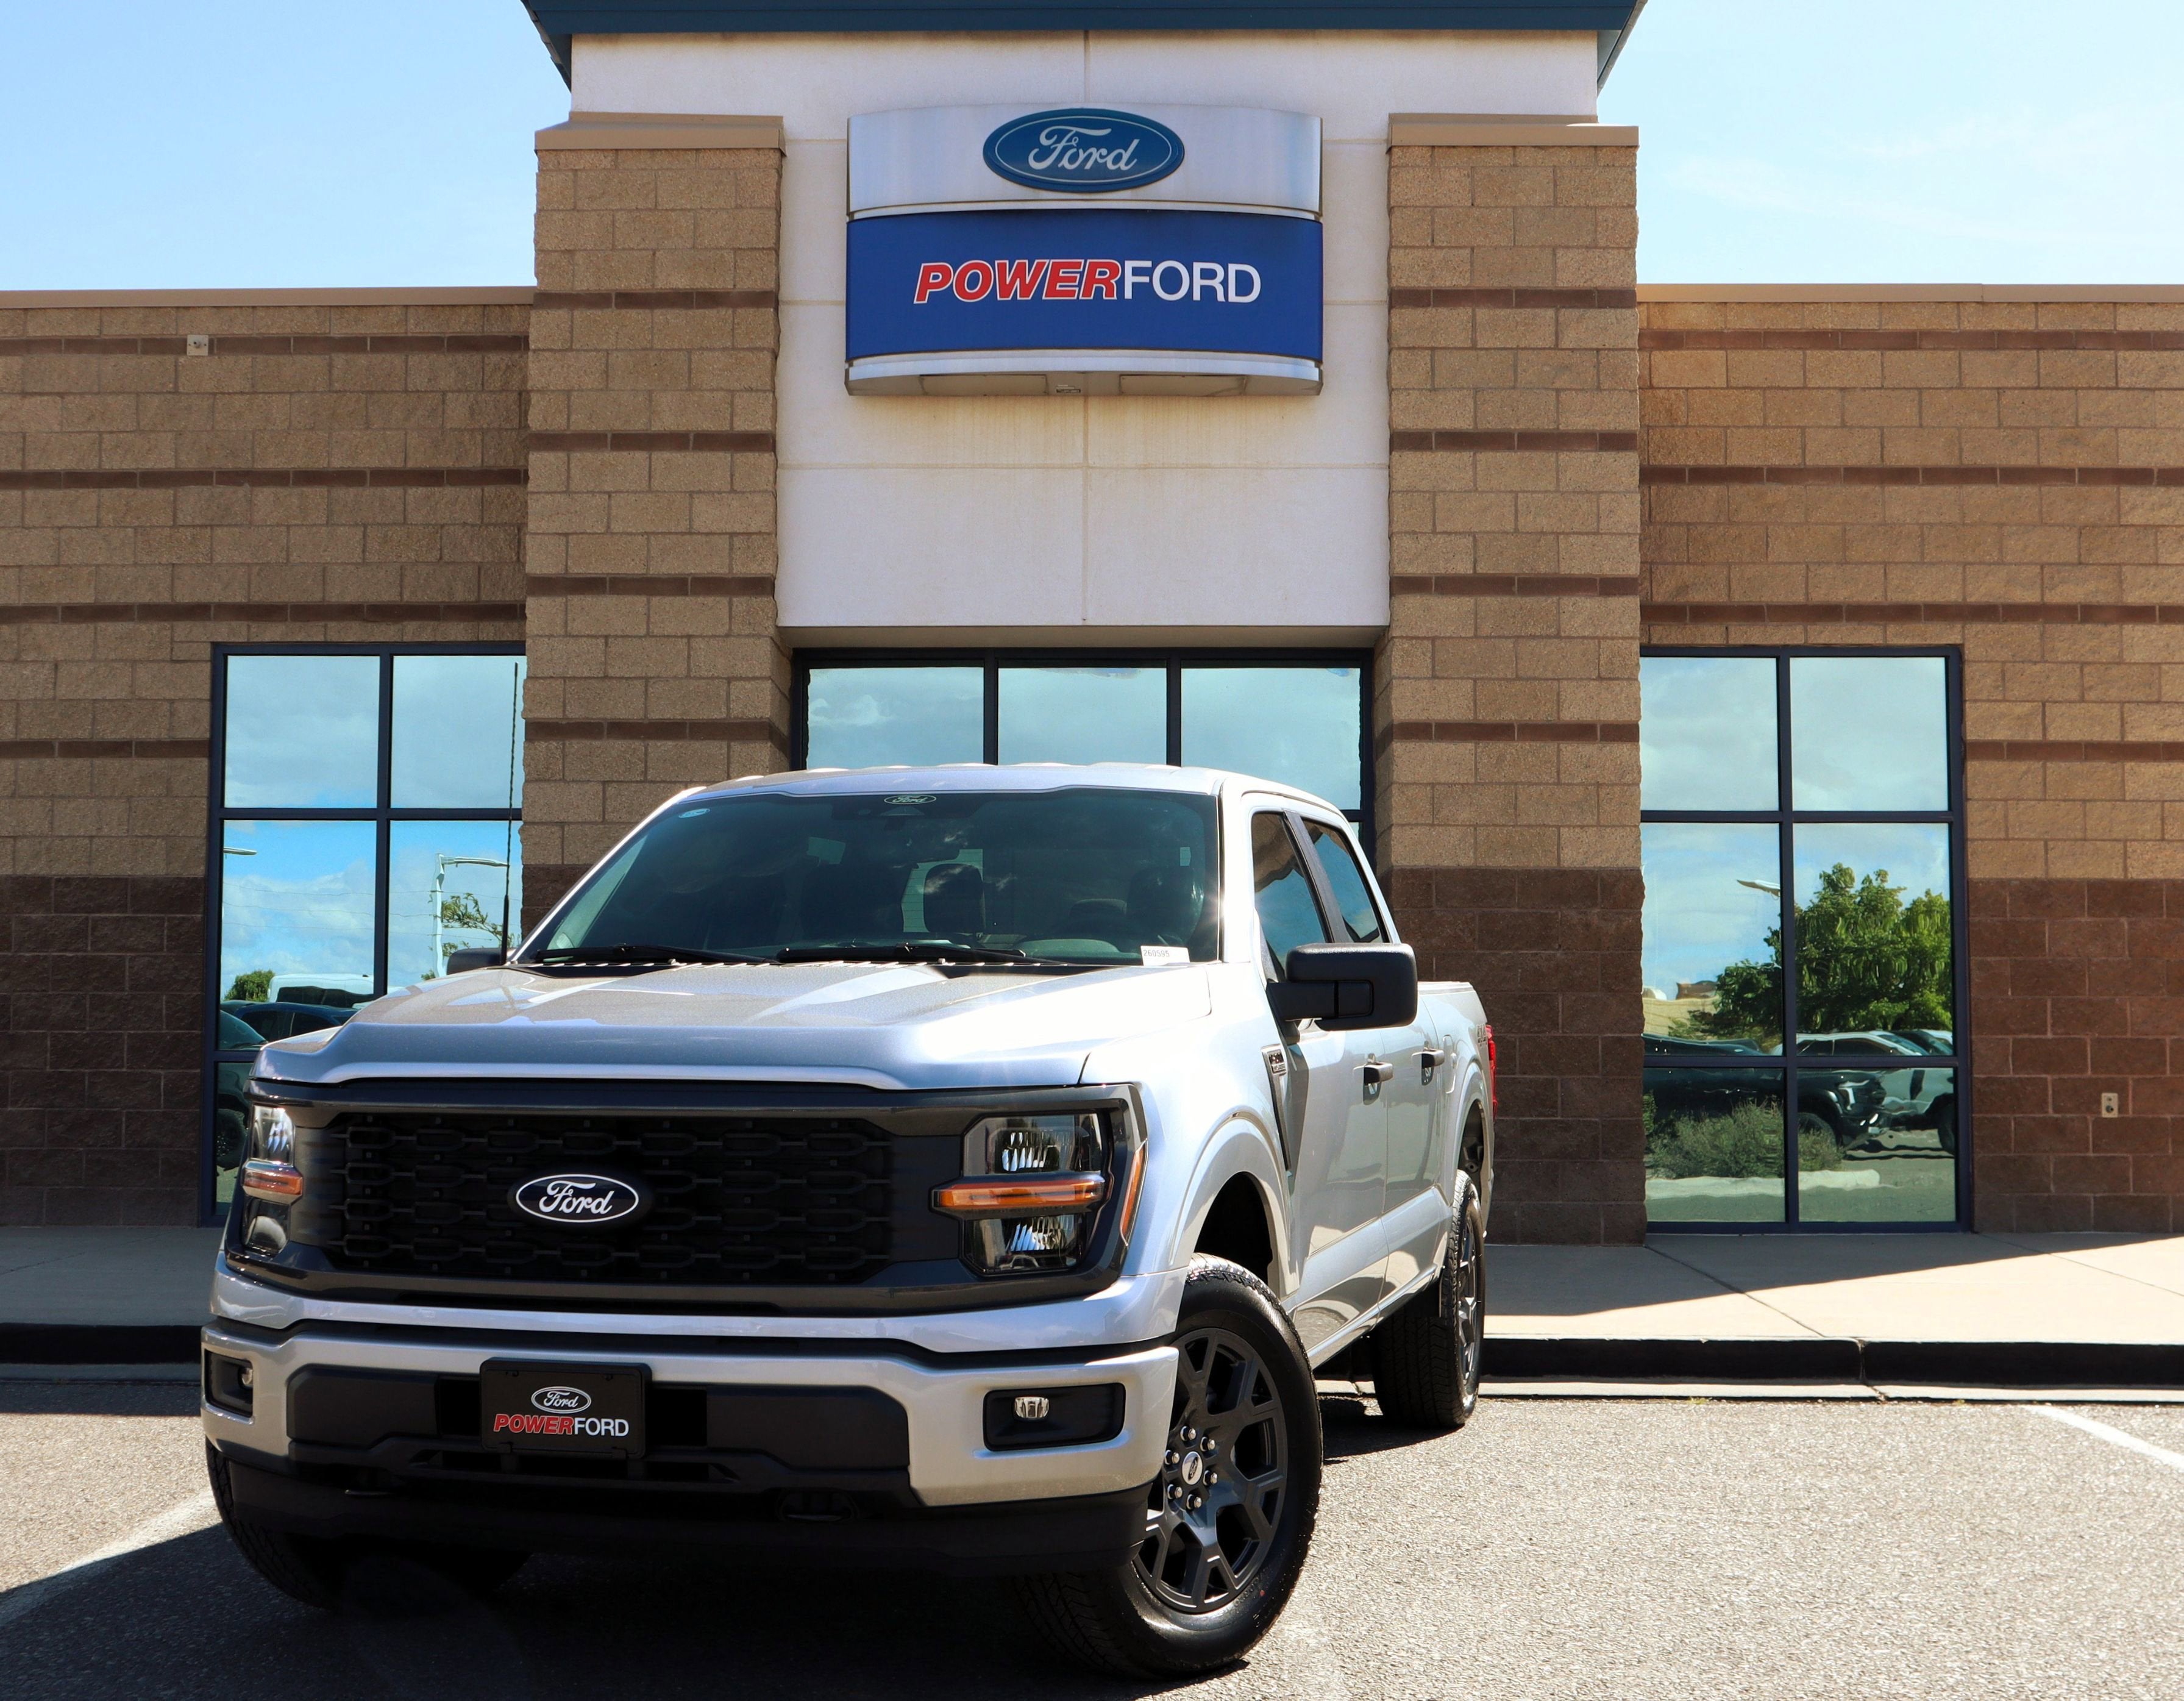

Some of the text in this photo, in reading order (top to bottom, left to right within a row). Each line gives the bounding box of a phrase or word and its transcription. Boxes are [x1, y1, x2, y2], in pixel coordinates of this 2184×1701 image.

[1028, 125, 1140, 171] Ford
[539, 1180, 615, 1214] Ford
[543, 1391, 579, 1408] Ford
